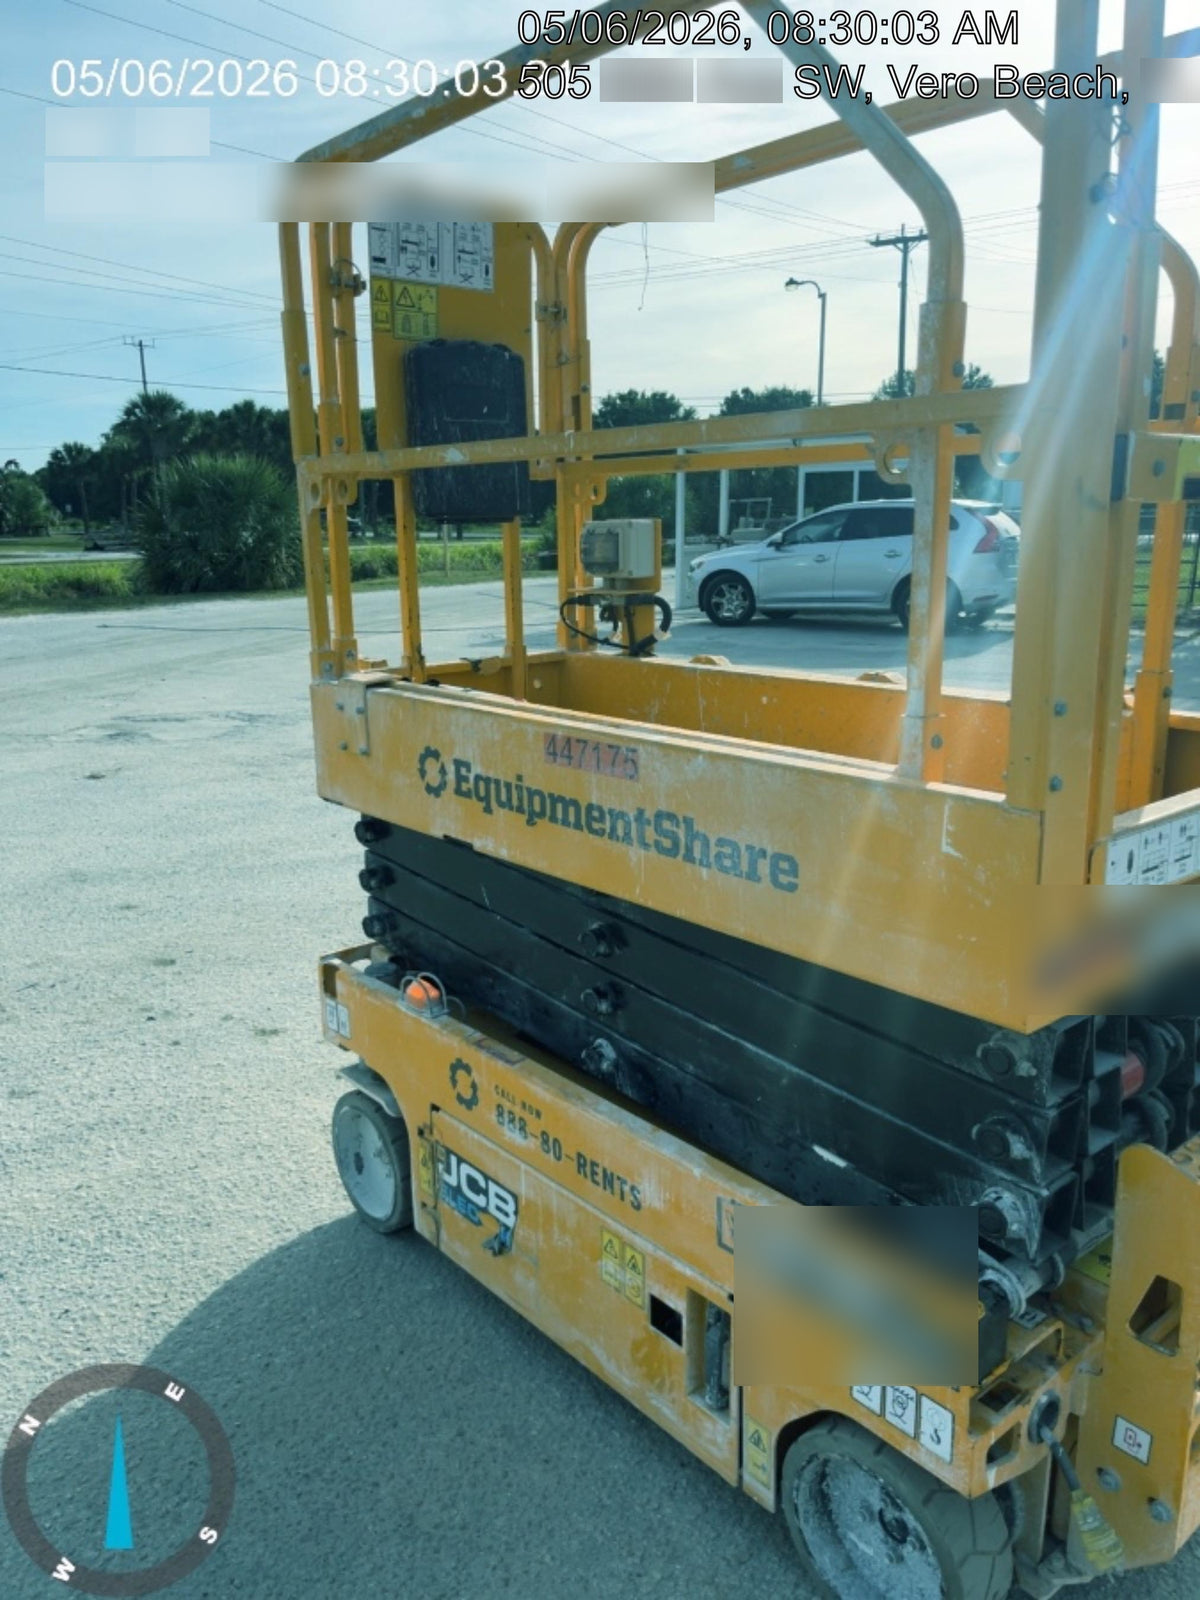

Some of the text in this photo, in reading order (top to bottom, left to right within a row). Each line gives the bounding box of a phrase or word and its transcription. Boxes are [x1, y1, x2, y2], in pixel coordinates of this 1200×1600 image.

[544, 735, 640, 781] 447175
[452, 757, 800, 894] EquipmentShare
[494, 1084, 542, 1121] CALL NOW
[438, 1153, 516, 1230] JCB
[495, 1103, 642, 1212] 888-80-RENTS
